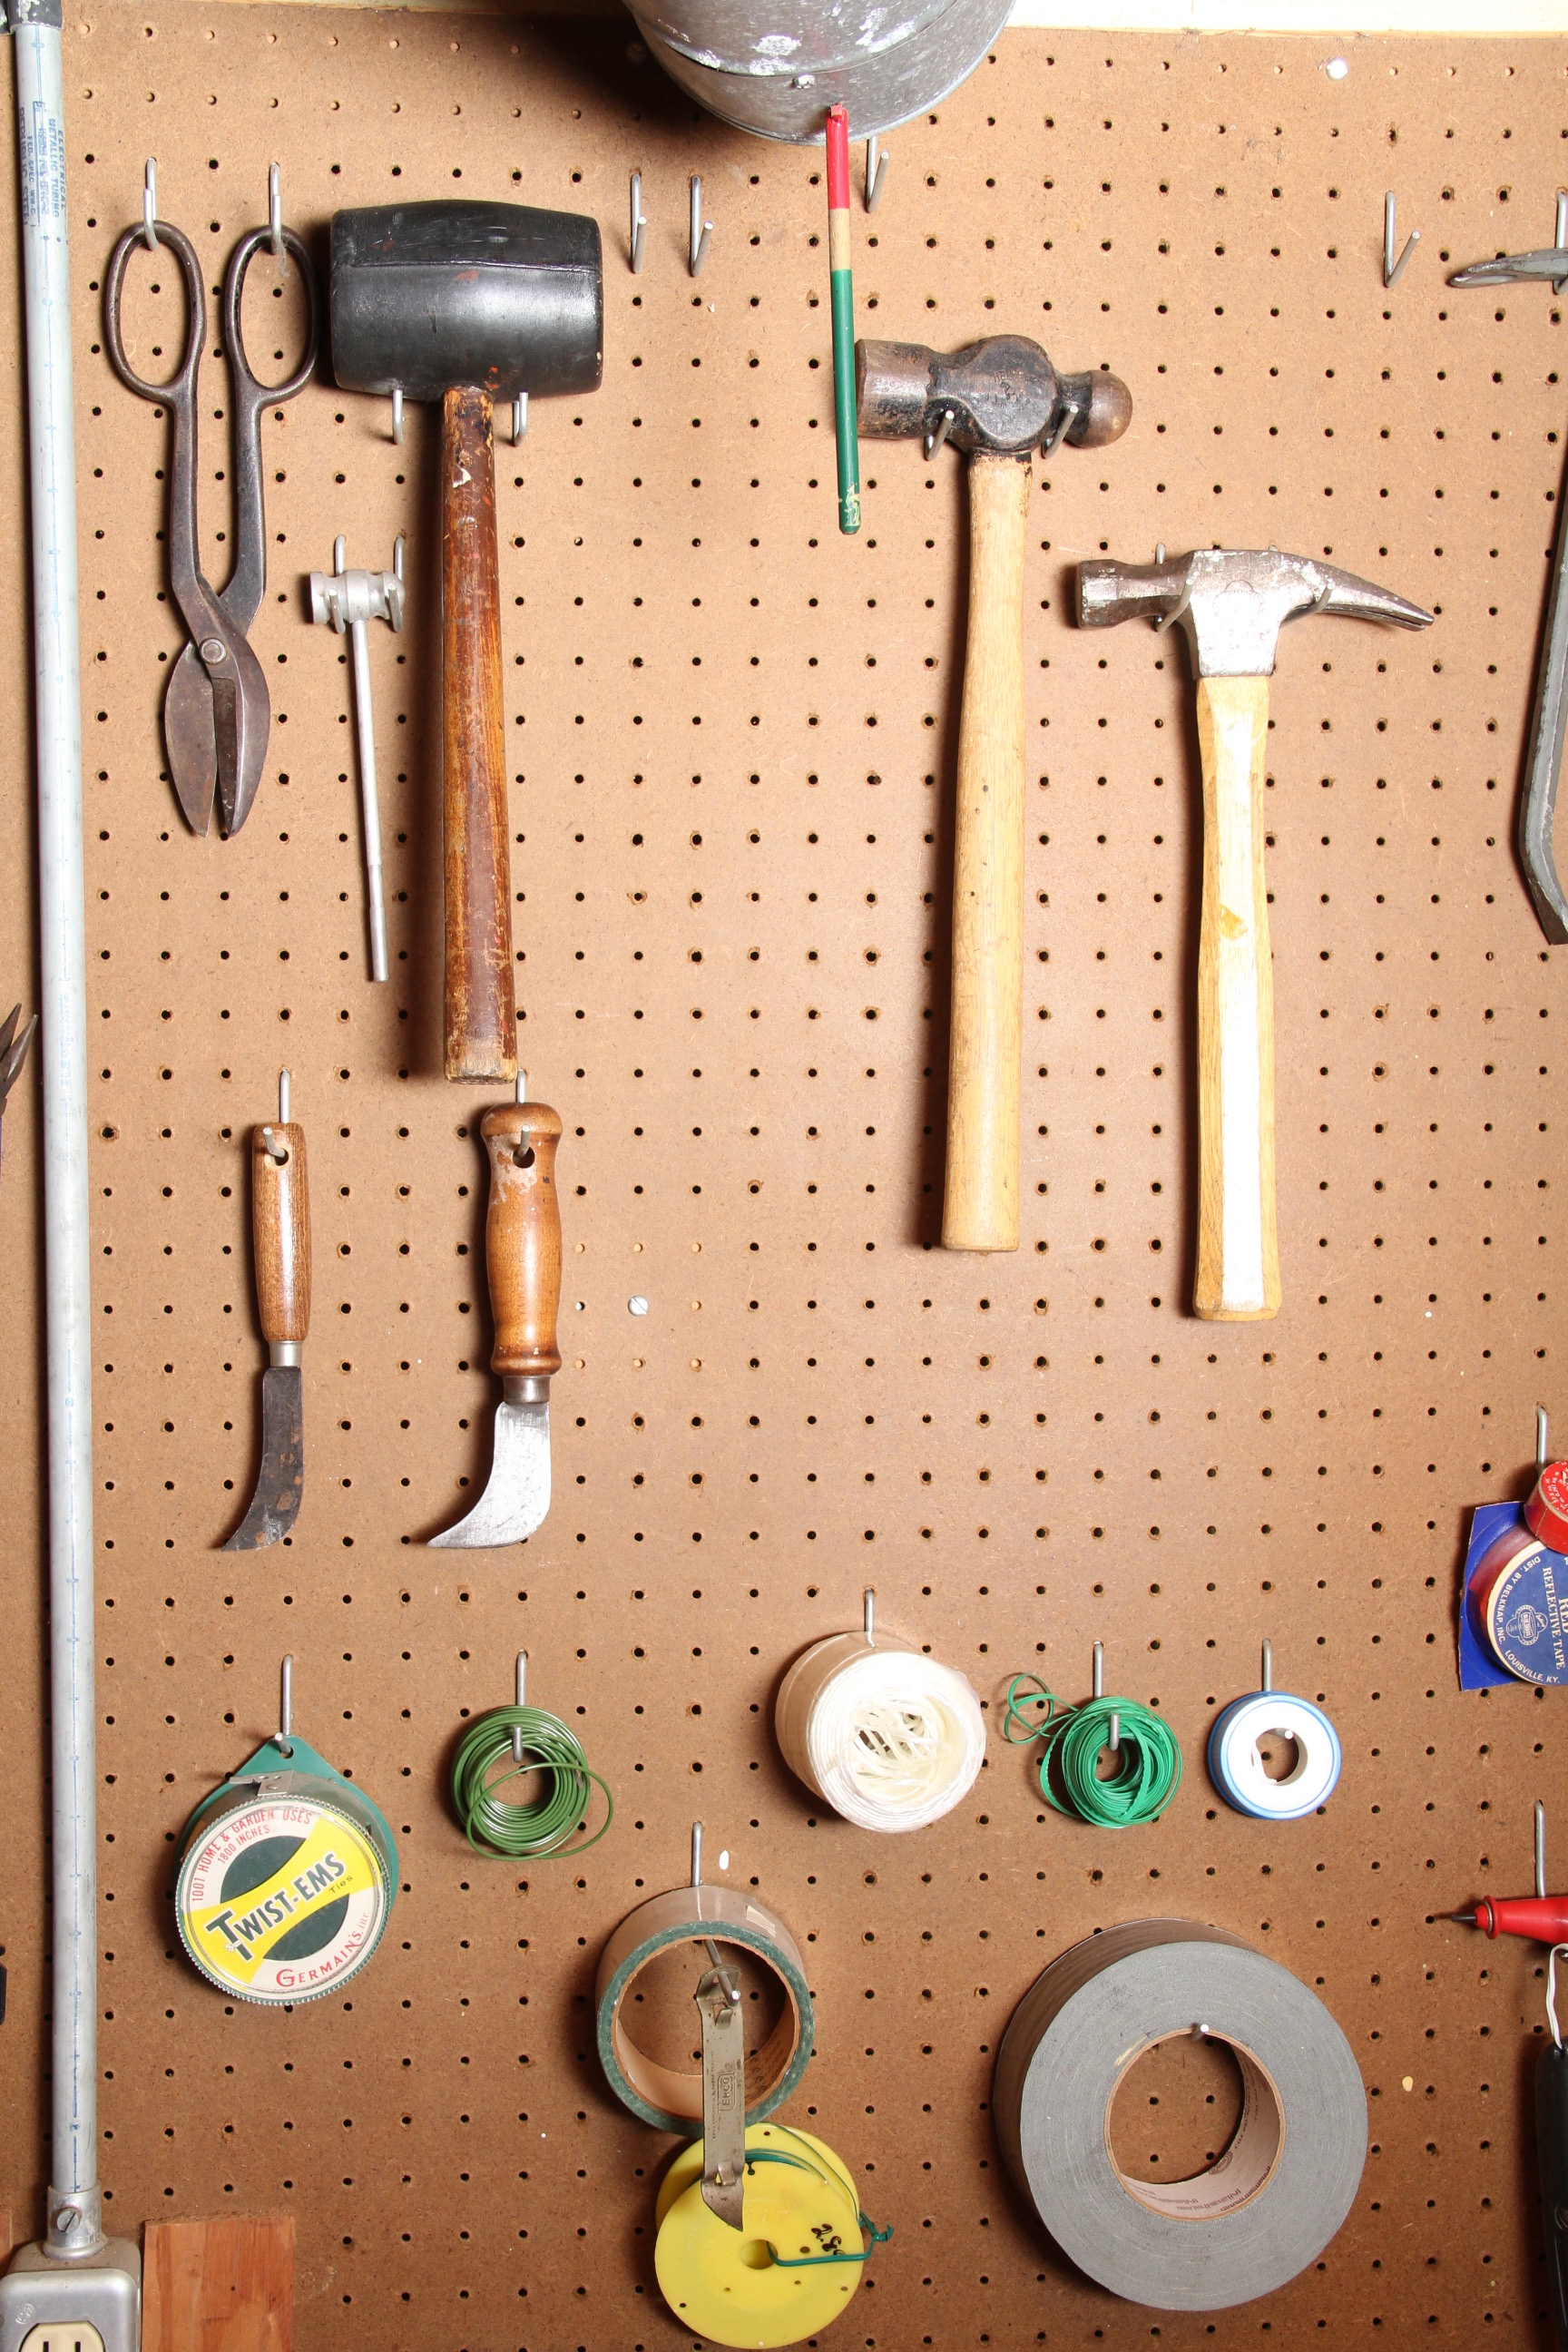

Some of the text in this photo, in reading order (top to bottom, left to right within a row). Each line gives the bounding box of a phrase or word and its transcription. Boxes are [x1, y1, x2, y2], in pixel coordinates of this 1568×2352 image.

[48, 117, 60, 219] METALLIC TUBING
[57, 129, 66, 211] ELECTRICAL
[1511, 1573, 1523, 1585] BY
[1520, 1555, 1542, 1573] DIST.
[1495, 1584, 1514, 1626] BELKNAP,
[1542, 1566, 1566, 1671] REFLECTIVE TAPE
[1558, 1597, 1568, 1634] RED
[1496, 1626, 1506, 1645] INC.
[1504, 1649, 1544, 1682] LOUISVILLE,
[1545, 1674, 1561, 1684] KY.
[191, 1808, 313, 1902] 1001 HOME & GARDEN USES
[217, 1825, 271, 1865] 1800 INCHES
[328, 1875, 354, 1895] Ties
